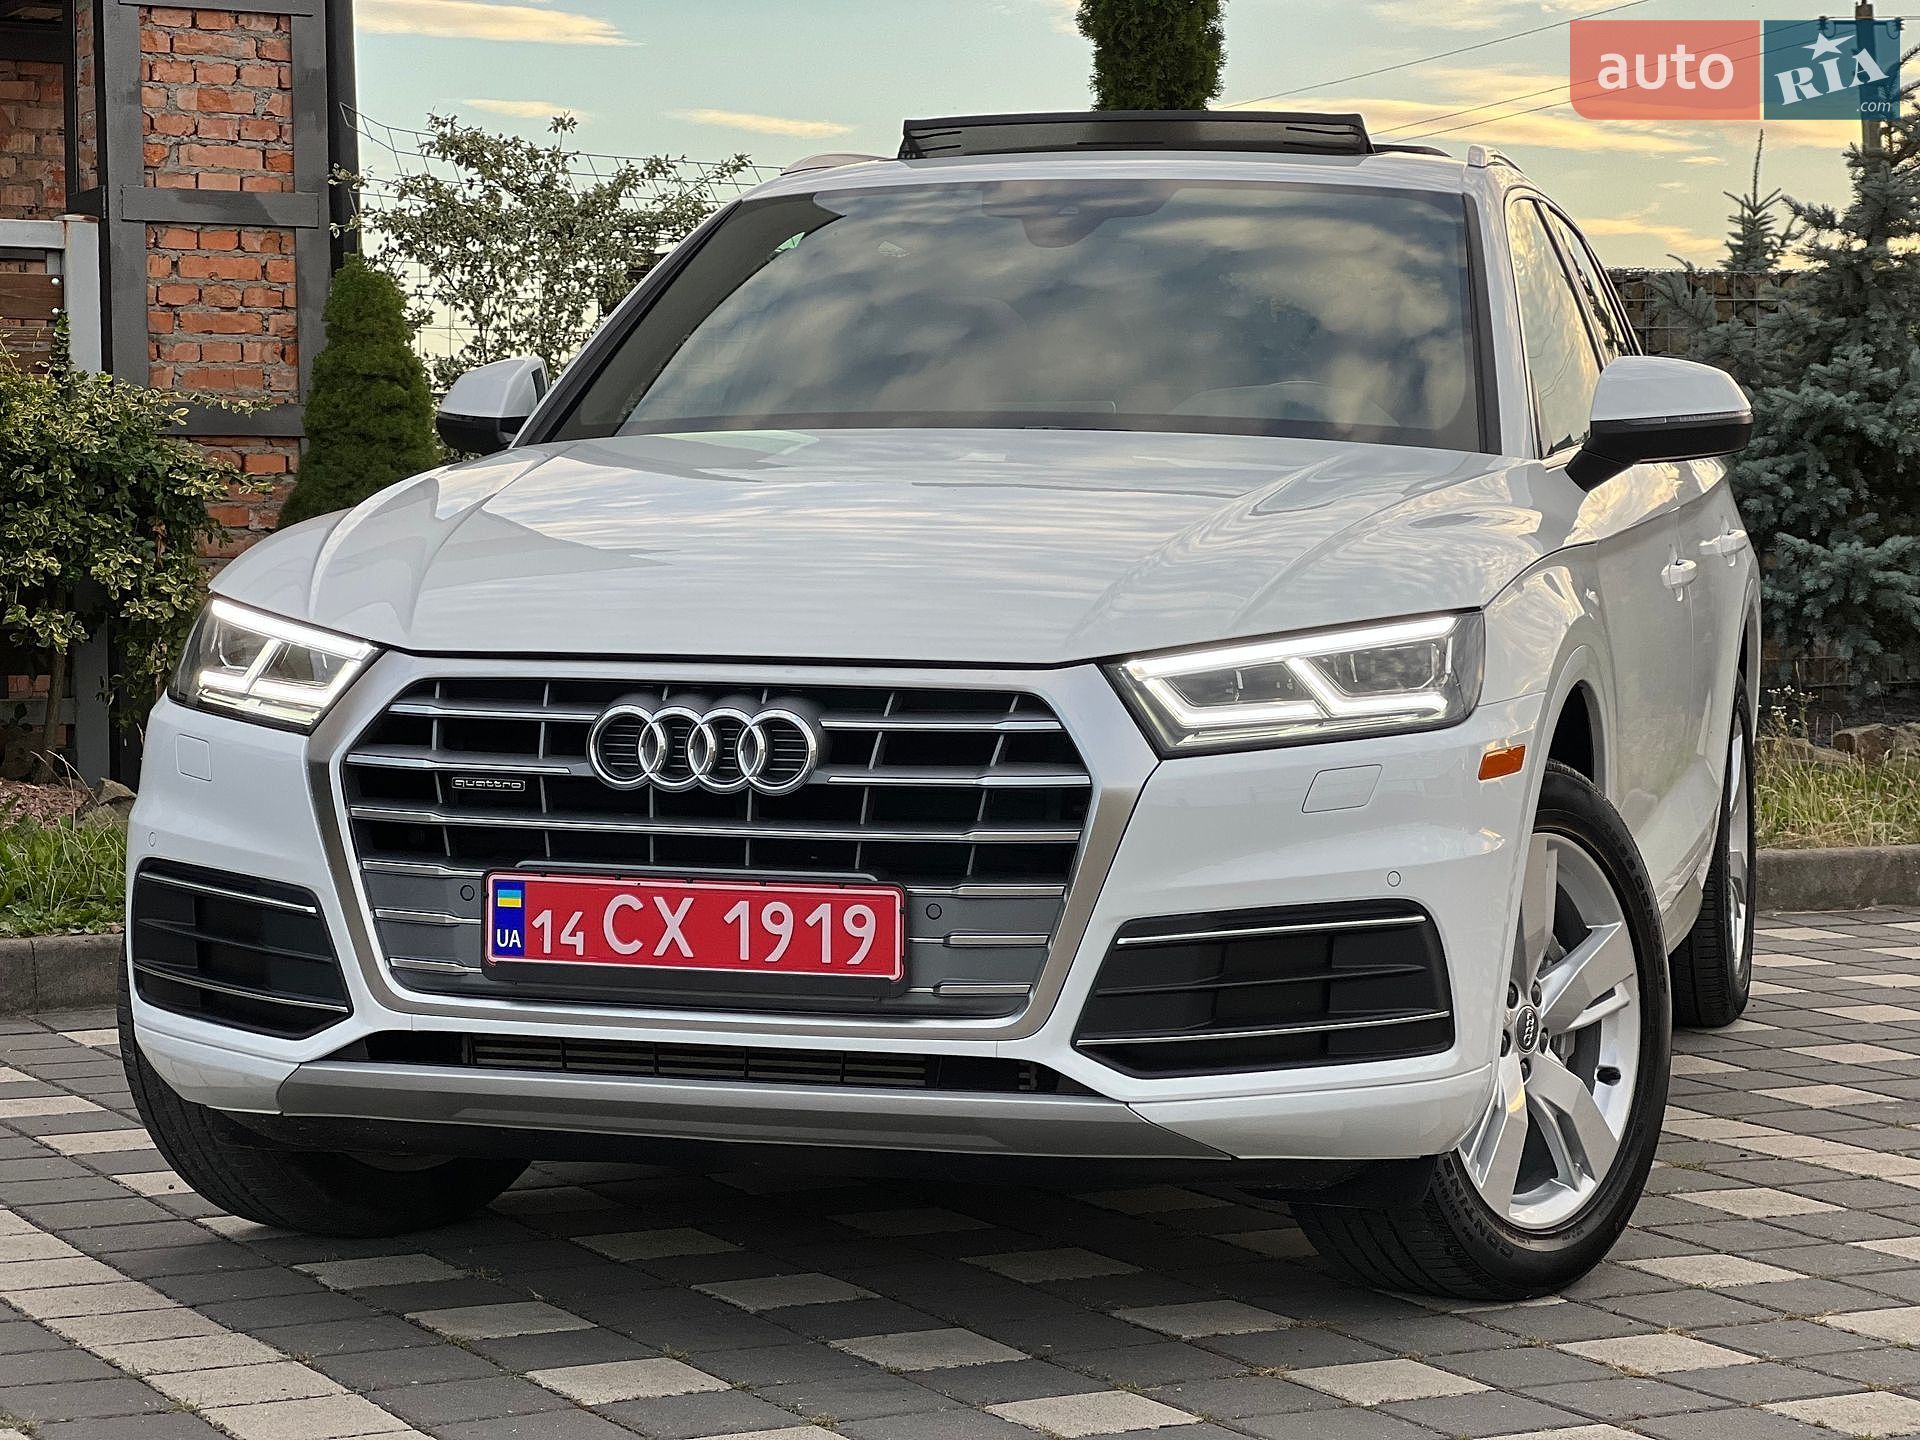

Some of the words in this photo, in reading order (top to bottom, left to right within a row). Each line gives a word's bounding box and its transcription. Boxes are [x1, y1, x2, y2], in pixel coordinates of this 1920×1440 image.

[454, 779, 522, 789] quattro
[496, 928, 522, 949] UA
[531, 908, 585, 956] 14
[603, 893, 695, 958] CX
[723, 900, 877, 965] 1919
